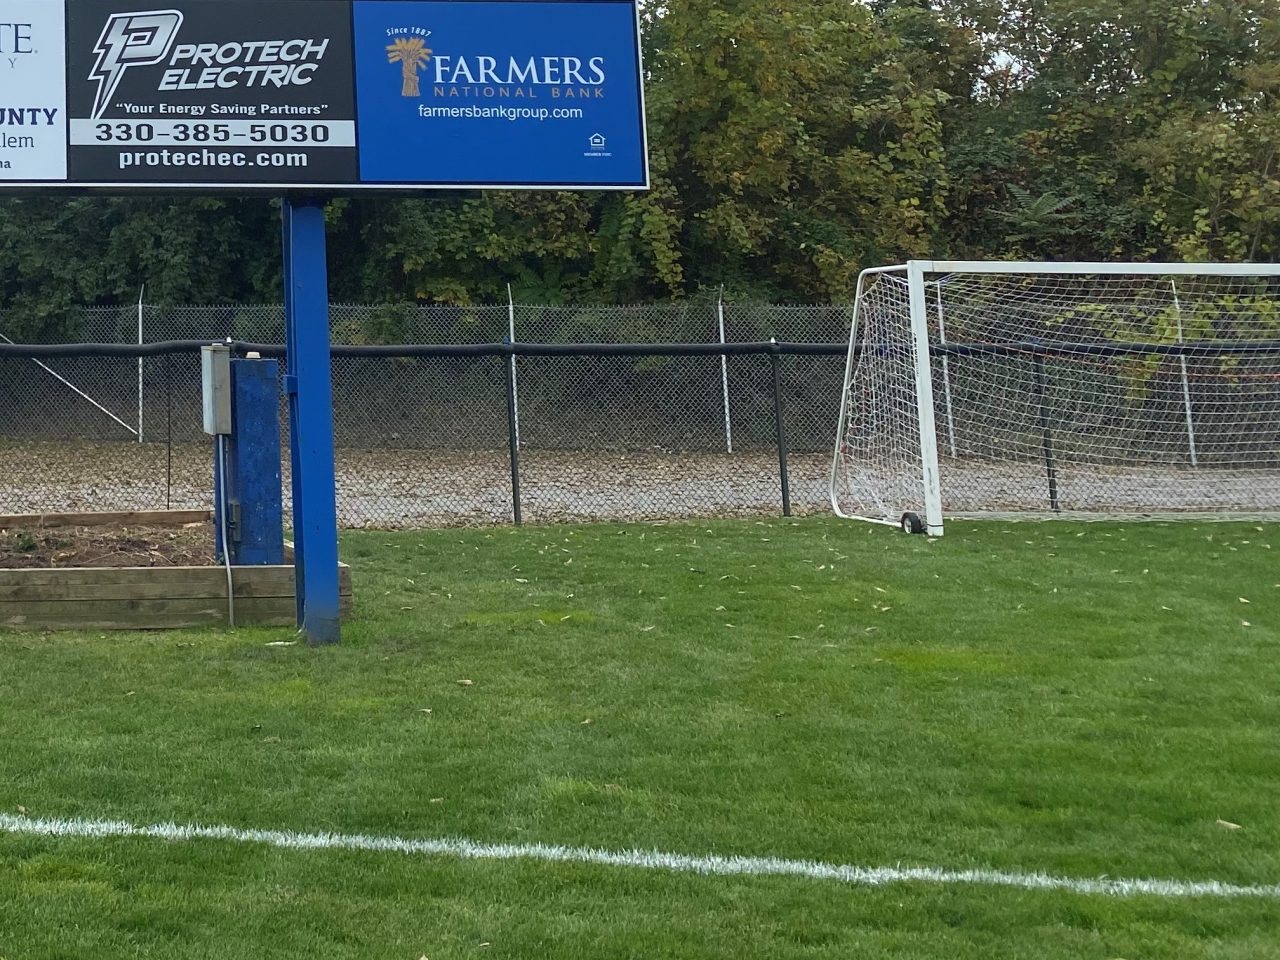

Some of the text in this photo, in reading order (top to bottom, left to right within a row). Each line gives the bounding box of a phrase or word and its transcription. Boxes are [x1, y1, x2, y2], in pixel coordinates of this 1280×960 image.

[386, 26, 432, 38] Since 1887
[169, 38, 330, 68] PROTECH
[157, 62, 320, 91] ELECTRIC
[432, 54, 606, 85] FARMERS
[434, 87, 605, 99] NATIONAL BANK
[159, 103, 207, 116] Energy
[210, 103, 257, 116] Saving
[418, 104, 584, 121] farmersbankgroup.com
[95, 123, 330, 143] 330-385-5030
[119, 148, 309, 169] protechec.com
